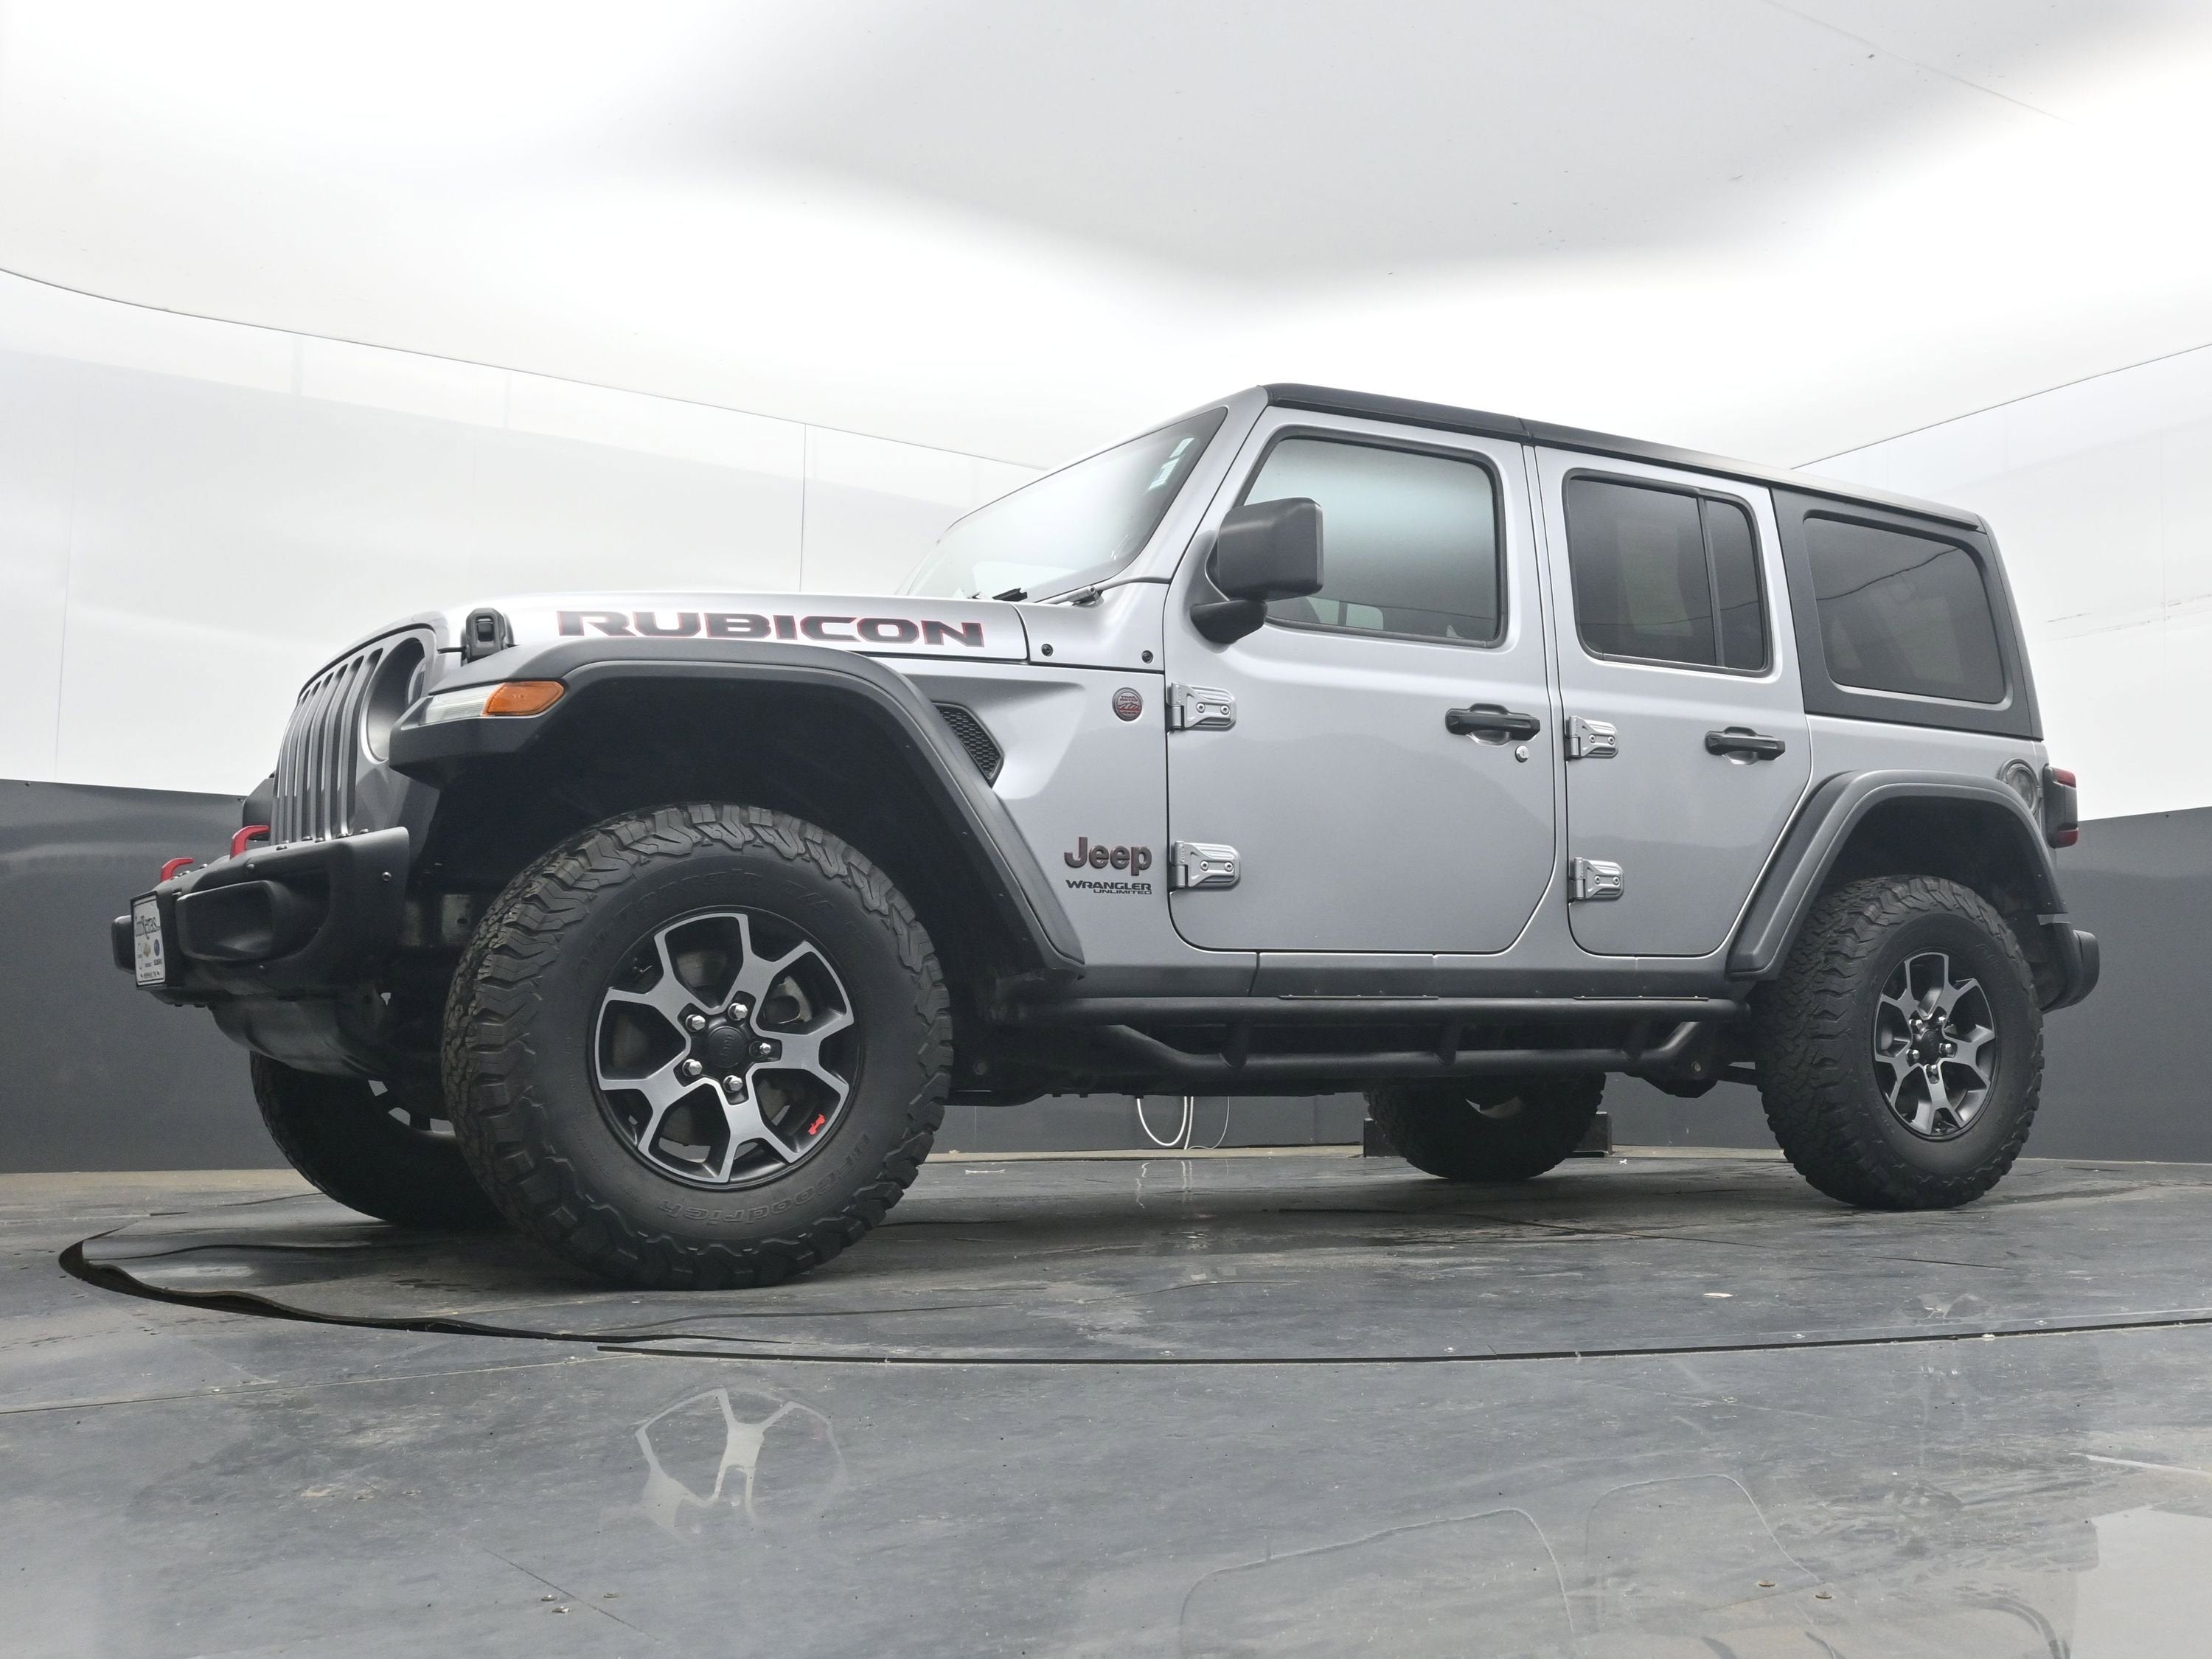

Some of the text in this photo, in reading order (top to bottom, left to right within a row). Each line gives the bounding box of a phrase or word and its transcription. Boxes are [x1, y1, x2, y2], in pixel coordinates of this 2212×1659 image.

[557, 611, 985, 647] RUBICON
[1064, 836, 1152, 876] Jeep
[1065, 880, 1152, 891] WRANGLER
